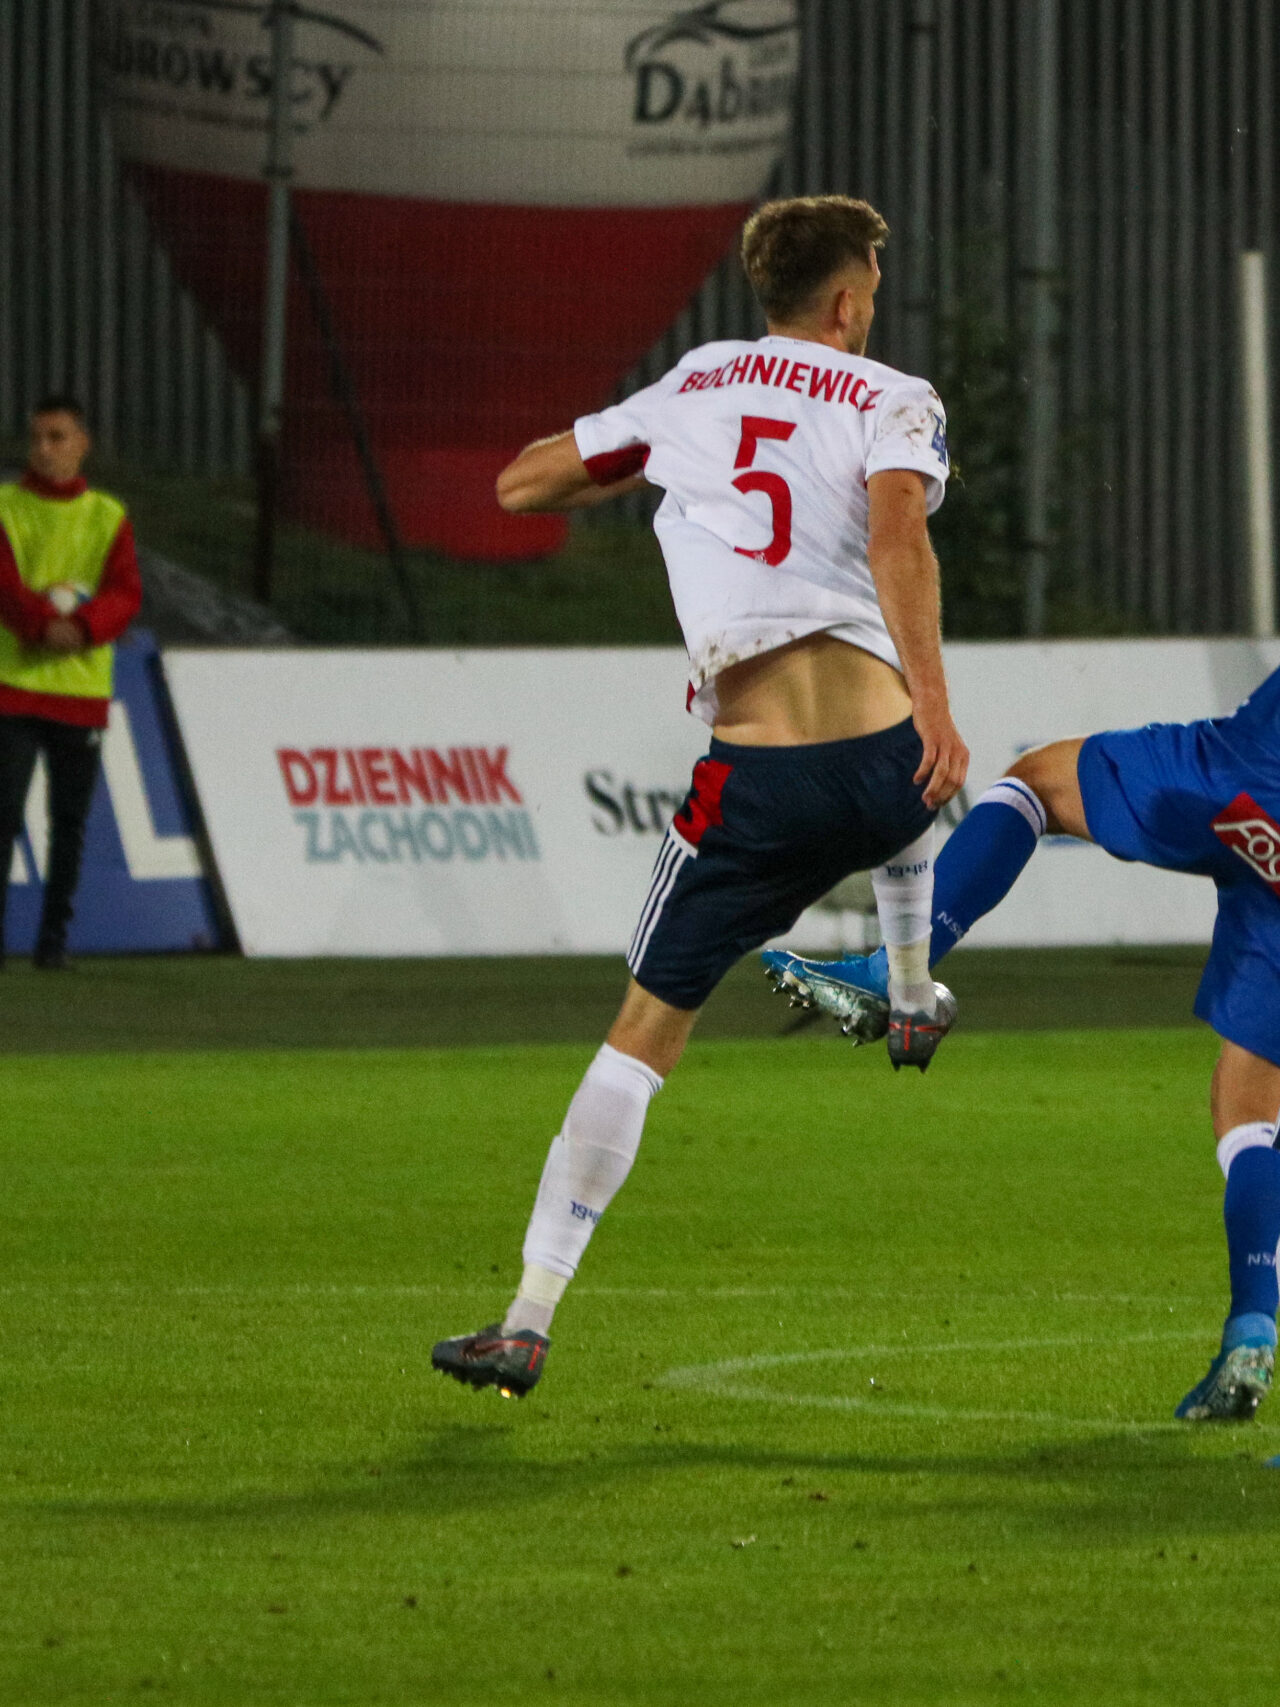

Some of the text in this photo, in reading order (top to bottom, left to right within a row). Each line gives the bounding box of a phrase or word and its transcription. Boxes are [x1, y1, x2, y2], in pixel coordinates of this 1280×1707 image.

[731, 415, 797, 567] 5
[275, 744, 524, 806] DZIENNIK
[293, 809, 542, 862] ZACHODNI
